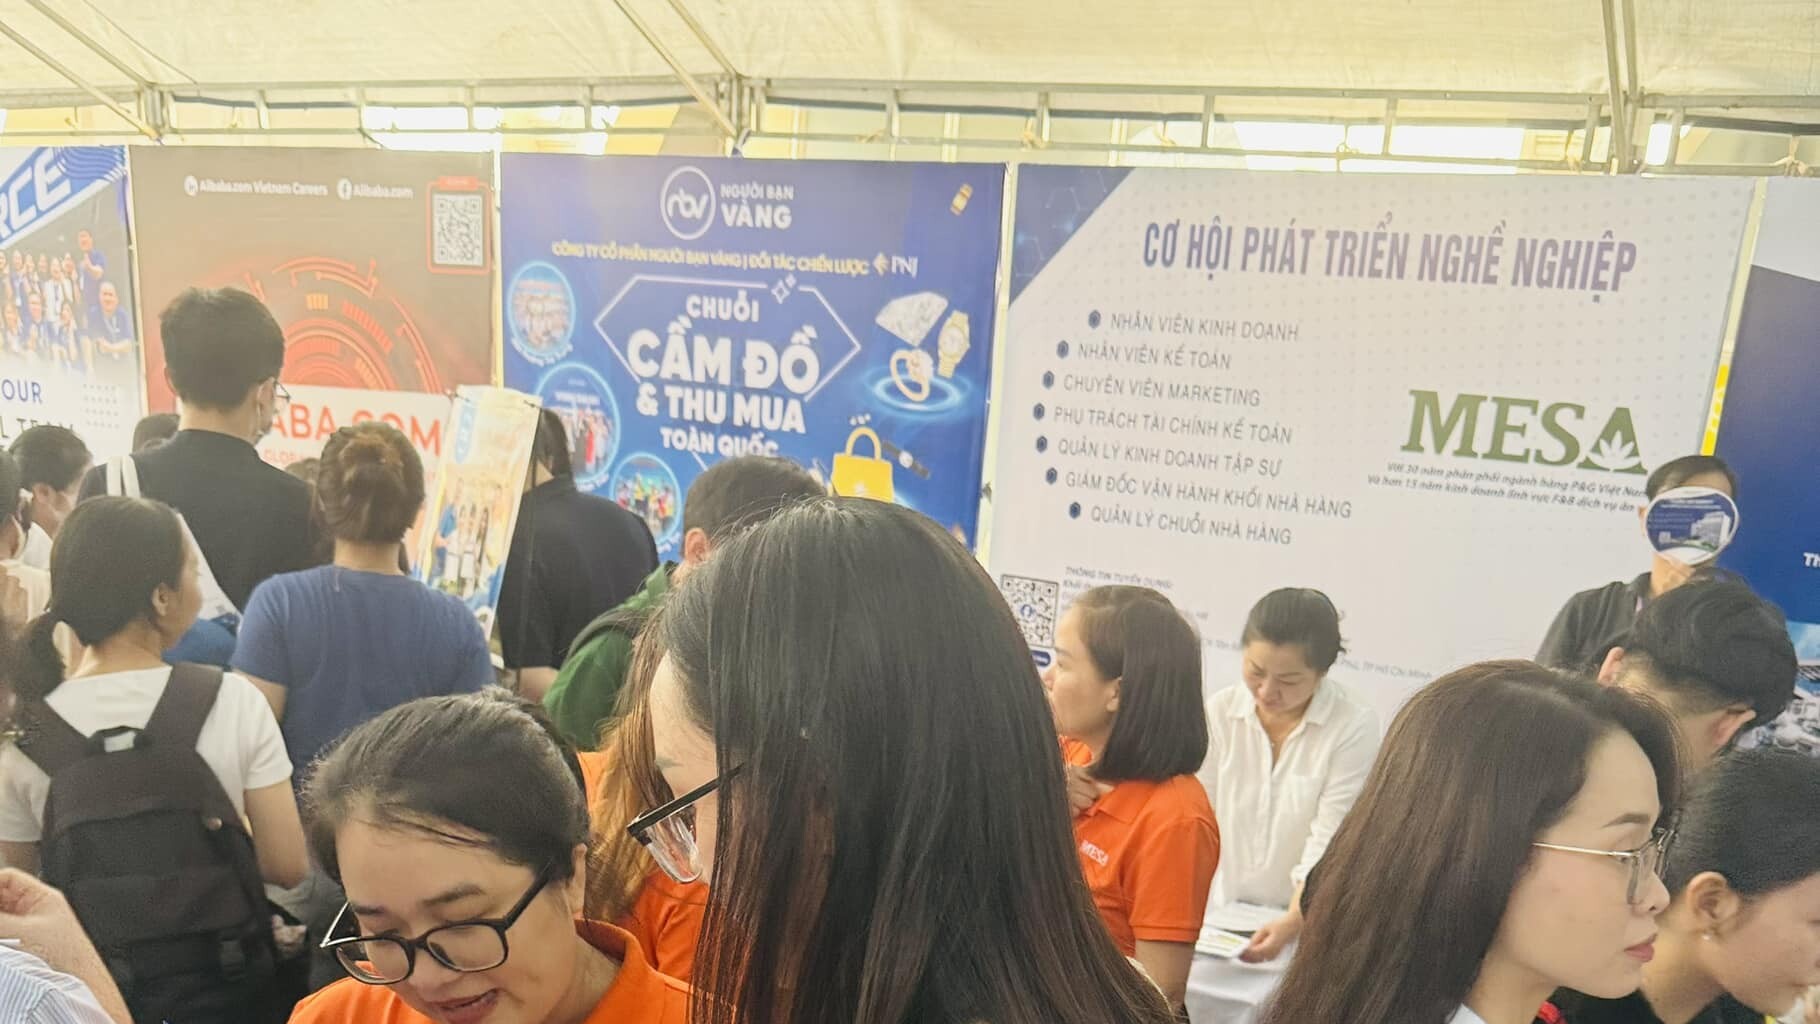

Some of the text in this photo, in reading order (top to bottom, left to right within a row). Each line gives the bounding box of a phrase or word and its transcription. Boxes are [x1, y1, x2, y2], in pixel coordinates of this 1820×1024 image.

[200, 179, 328, 195] Alibaba.com Vietnam Careers
[351, 185, 413, 198] Alibaba.com
[720, 182, 794, 200] NGƯỜI BẠN
[721, 199, 792, 229] VÀNG
[1144, 211, 1637, 303] CƠ HỘI PHÁT TRIỂN NGHỀ NGHIỆP
[1199, 318, 1236, 338] KINH
[1241, 320, 1299, 342] DOANH
[627, 315, 820, 395] CẦM ĐỒ
[636, 382, 659, 416] &
[664, 384, 727, 425] THU
[733, 393, 806, 434] MUA
[1168, 383, 1261, 408] MARKETING
[660, 426, 779, 458] TOÀN QUỐC
[1400, 389, 1648, 475] MESA
[1125, 443, 1159, 464] KINH
[1164, 449, 1217, 471] DOANH
[1572, 479, 1597, 492] P&G
[1176, 482, 1219, 505] HÀNH
[1266, 489, 1299, 512] NHÀ
[1304, 496, 1352, 519] HÀNG
[1209, 517, 1241, 540] NHÀ
[1246, 522, 1291, 546] HÀNG
[1080, 840, 1109, 867] MESA
